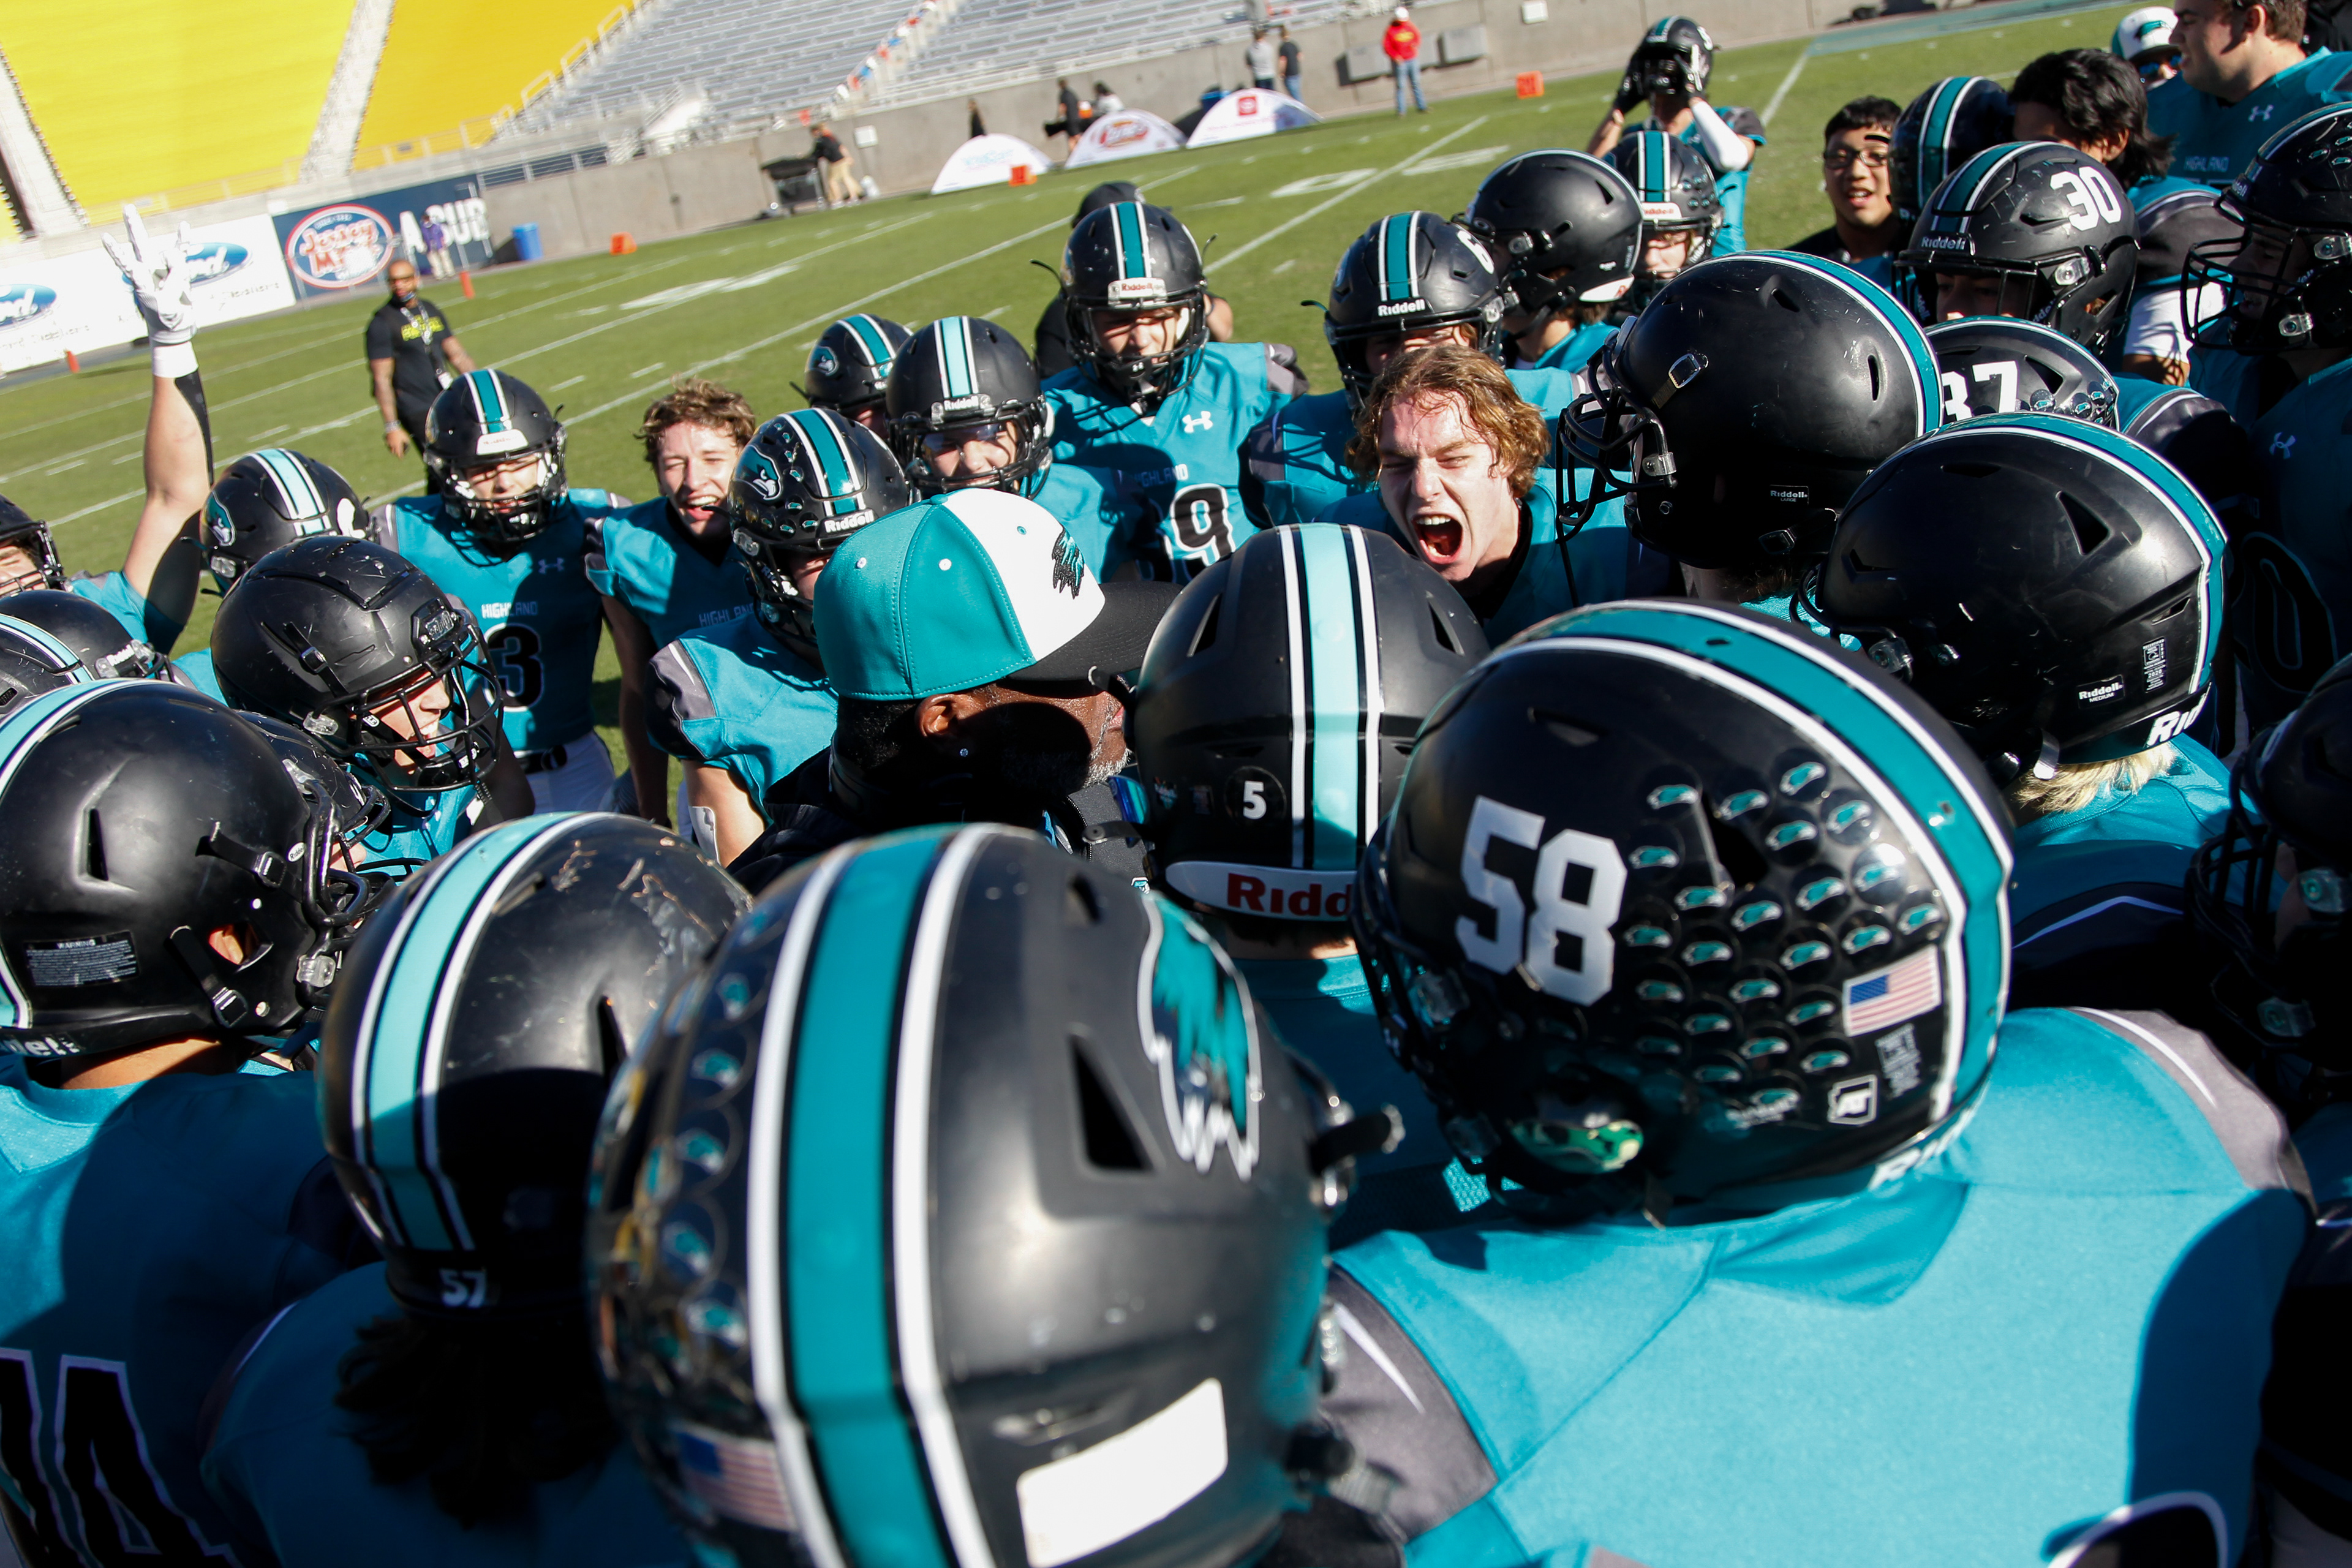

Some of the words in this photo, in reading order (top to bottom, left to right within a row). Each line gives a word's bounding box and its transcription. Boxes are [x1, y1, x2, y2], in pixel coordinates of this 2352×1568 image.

[2050, 166, 2122, 231] 30
[1921, 235, 1966, 250] Riddell
[1378, 298, 1426, 317] Riddell
[1941, 360, 2018, 421] 37
[944, 396, 979, 411] Riddell
[824, 509, 875, 533] Riddell
[483, 622, 545, 713] 3
[2148, 669, 2162, 679] 2020
[2079, 682, 2123, 700] Riddell
[2089, 692, 2114, 703] MEDIUM
[1243, 780, 1267, 820] 5
[1455, 796, 1628, 1006] 58
[57, 939, 96, 949] WARNING
[439, 1265, 488, 1309] 57
